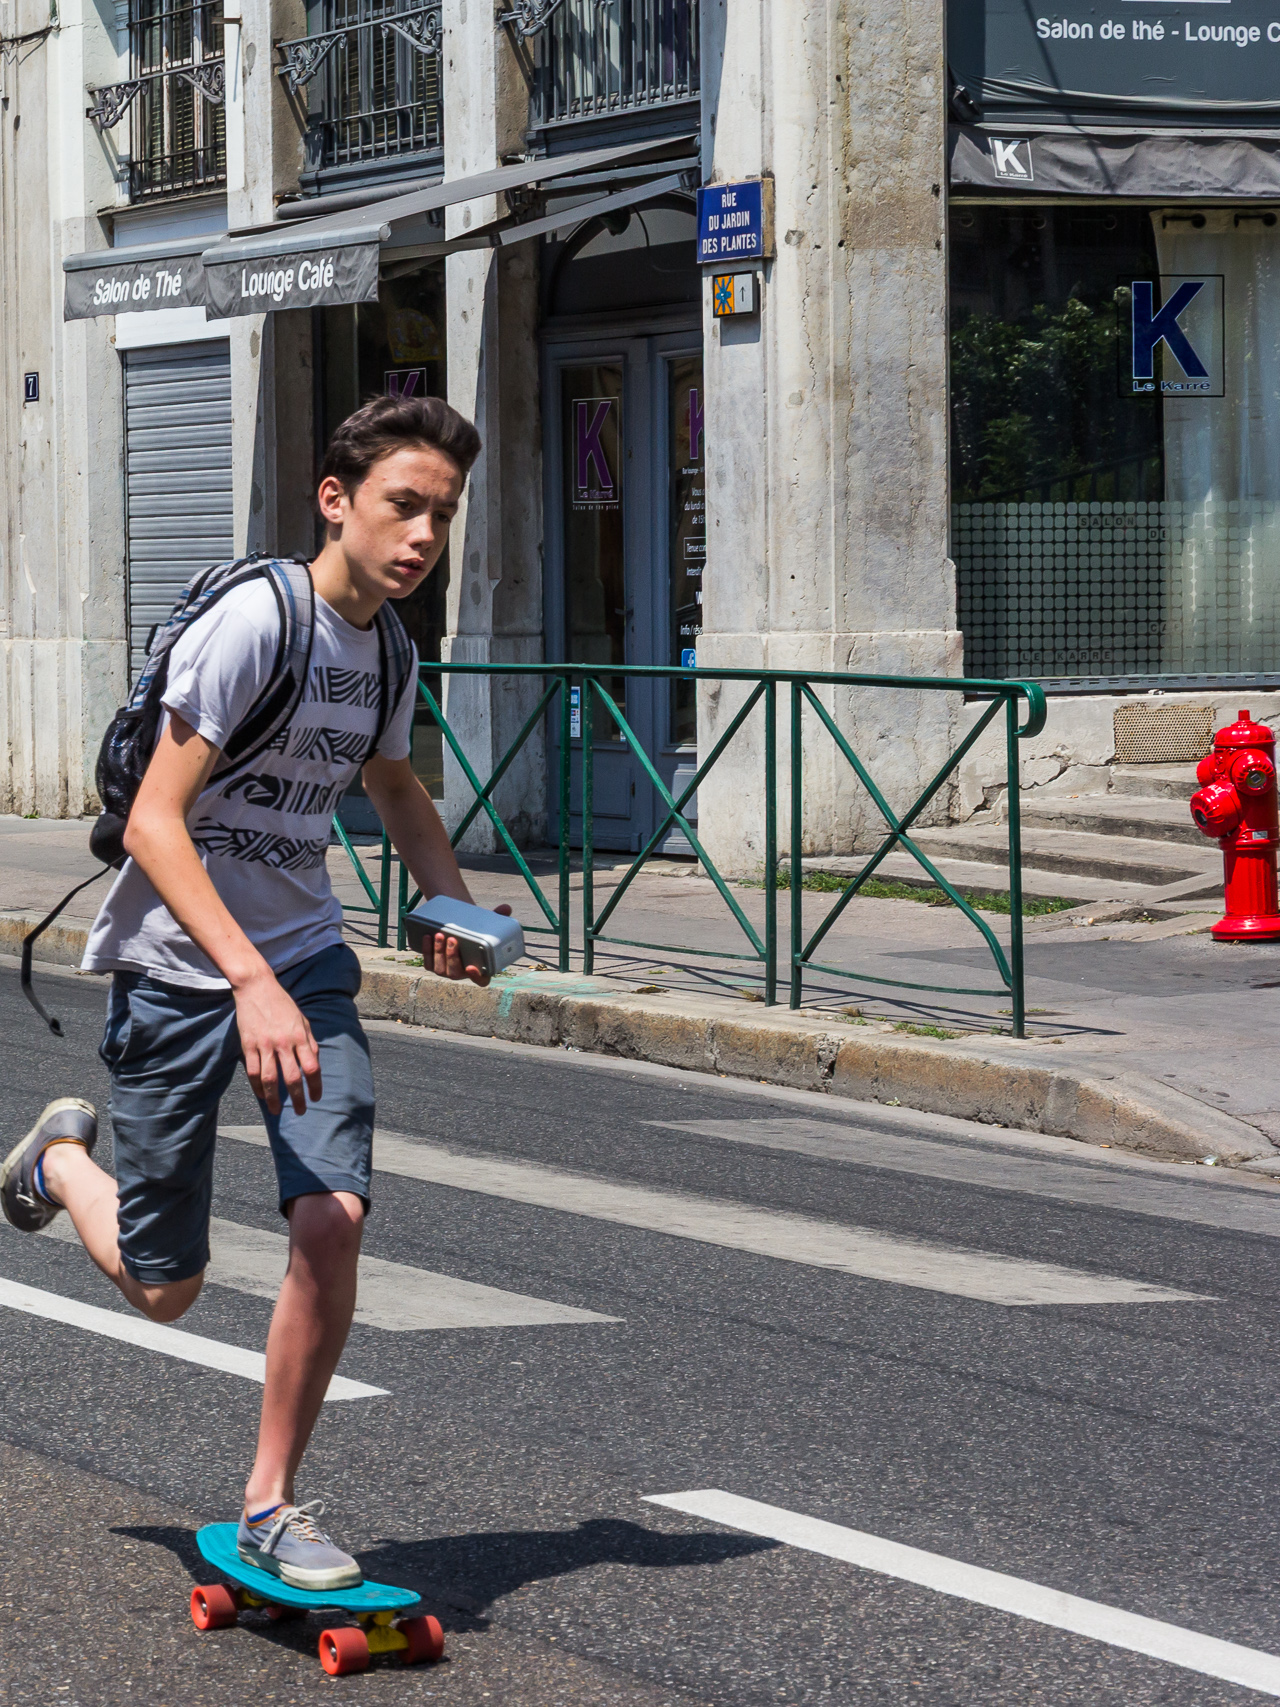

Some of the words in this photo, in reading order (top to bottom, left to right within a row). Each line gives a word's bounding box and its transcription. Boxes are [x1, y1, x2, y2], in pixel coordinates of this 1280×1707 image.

[1036, 18, 1093, 39] Salon
[1100, 20, 1125, 39] de
[1132, 20, 1164, 41] thé
[1185, 22, 1261, 47] Lounge
[994, 140, 1027, 173] K
[722, 192, 737, 207] RUE
[708, 215, 719, 231] DU
[721, 211, 750, 229] JARDIN
[702, 238, 717, 254] DES
[721, 233, 756, 252] PLANTES
[93, 277, 130, 305] Salon
[132, 274, 150, 300] de
[156, 268, 182, 298] Thé
[242, 268, 294, 301] Lounge
[298, 257, 333, 290] Café
[1132, 281, 1209, 379] K
[27, 377, 34, 396] 7
[1133, 381, 1155, 391] Le
[1161, 381, 1210, 391] Karré
[578, 401, 613, 488] K
[1081, 517, 1135, 526] SALON
[1151, 530, 1166, 538] DE
[1023, 652, 1040, 660] LE
[1057, 652, 1110, 660] KARRE
